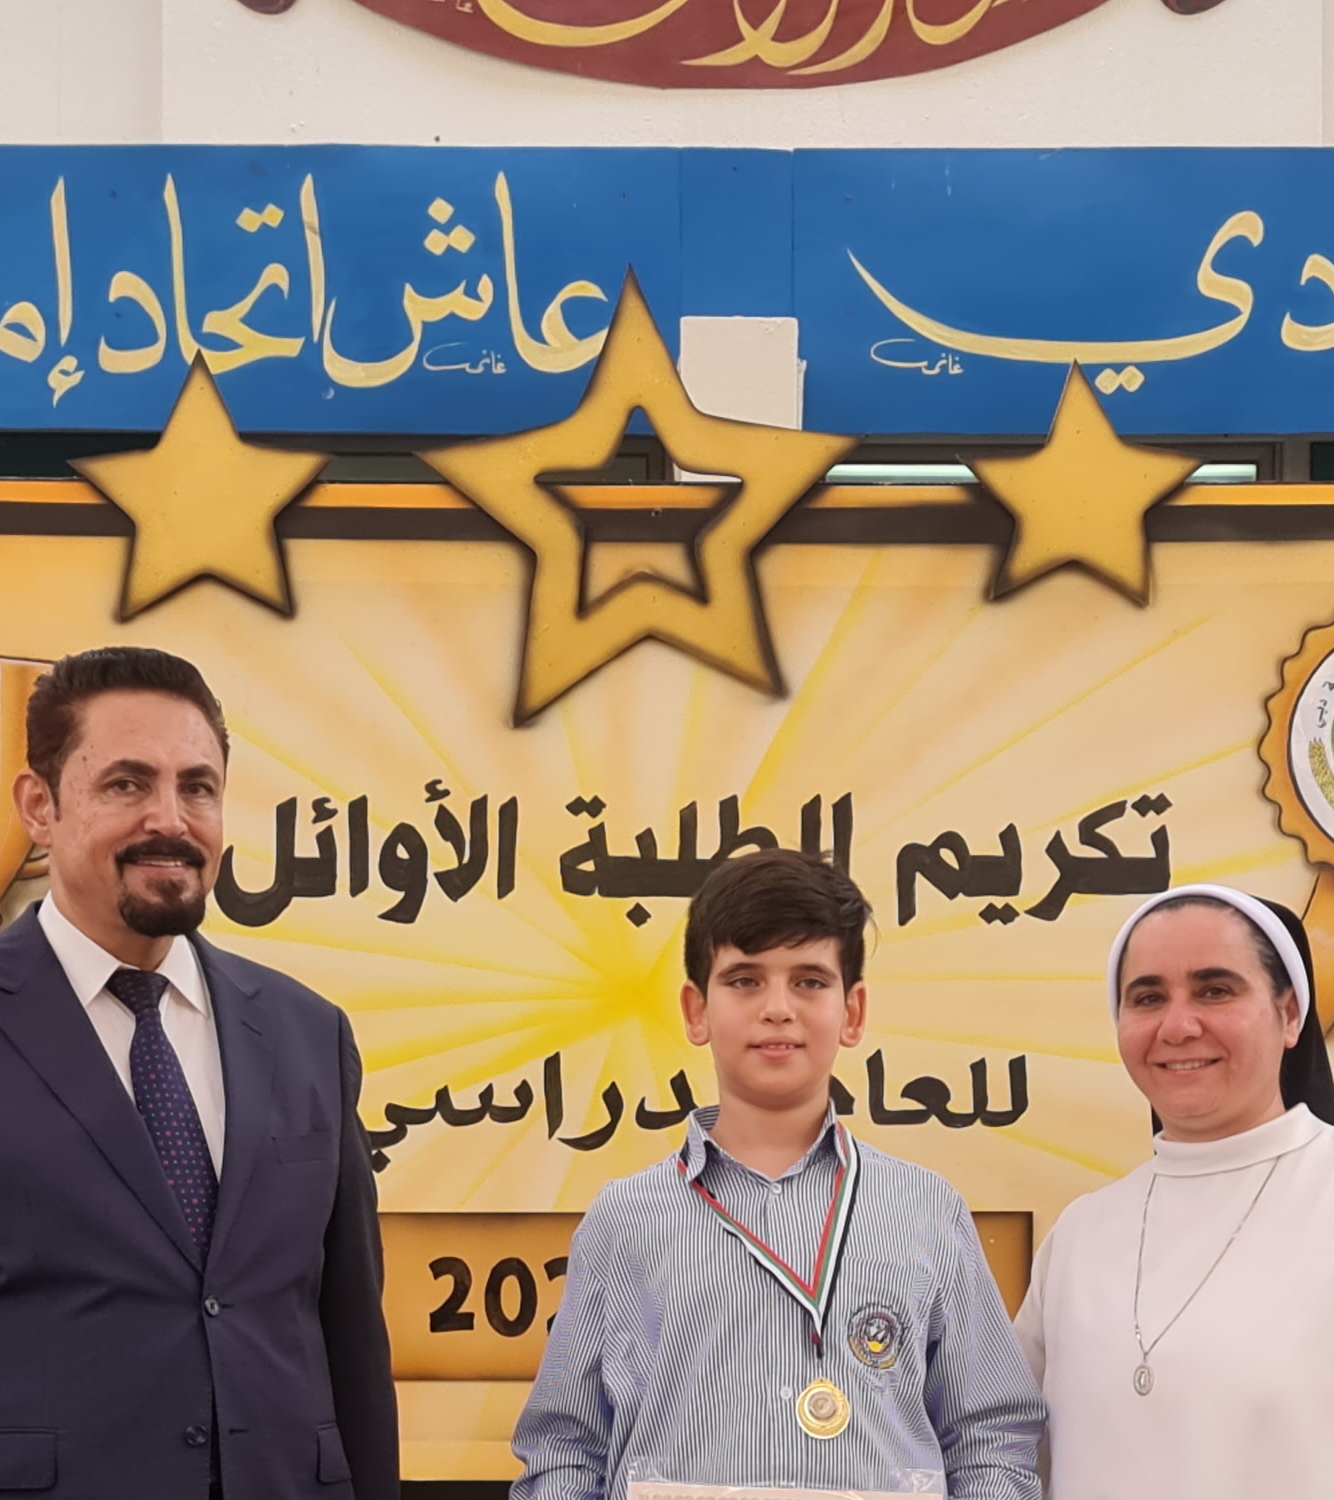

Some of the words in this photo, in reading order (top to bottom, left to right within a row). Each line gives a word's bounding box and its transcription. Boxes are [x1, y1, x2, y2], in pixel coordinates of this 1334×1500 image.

[98, 172, 326, 375] اتحاد
[323, 170, 611, 388] عاش
[1315, 698, 1329, 729] دبي
[213, 778, 518, 928] الأوائل
[896, 792, 1173, 927] تكريم
